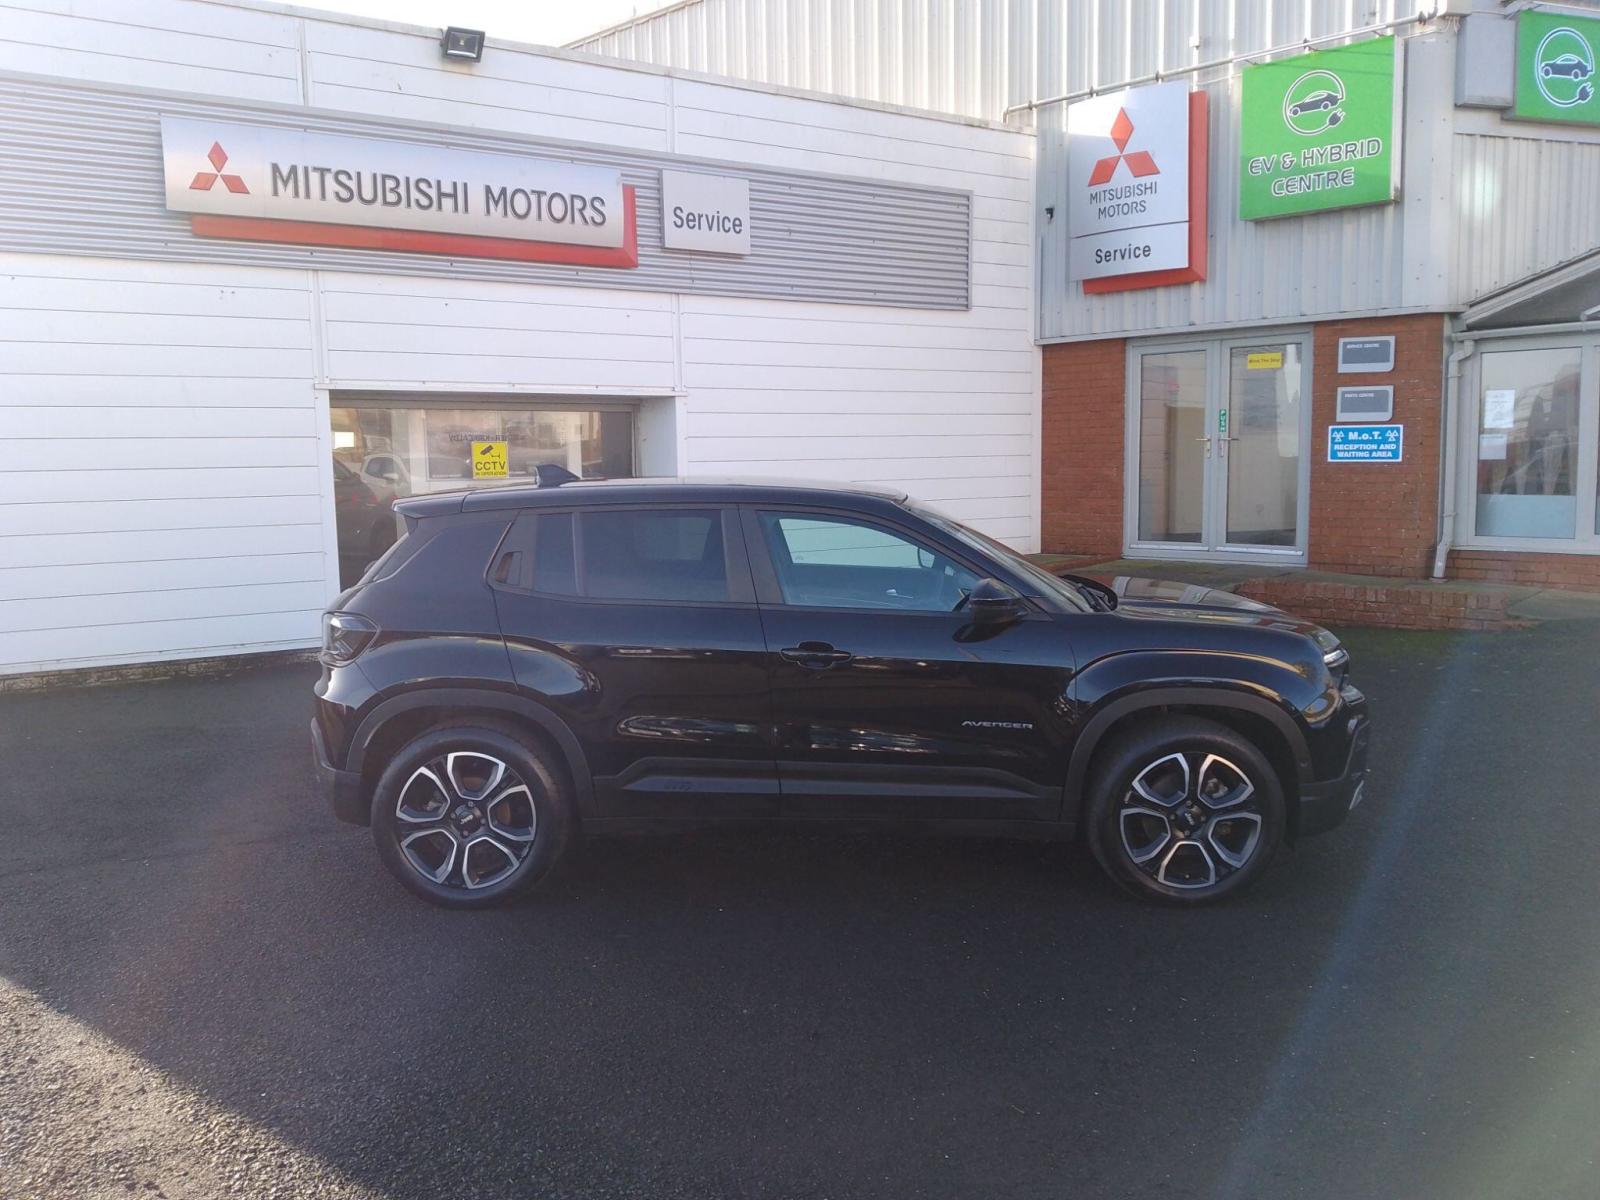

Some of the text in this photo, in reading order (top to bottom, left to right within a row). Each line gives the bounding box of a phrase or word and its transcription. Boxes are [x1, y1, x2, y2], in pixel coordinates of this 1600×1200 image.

[1249, 137, 1382, 175] EV & HYBRID
[1089, 181, 1158, 204] MITSUBISHI
[1272, 167, 1354, 197] CENTRE
[270, 162, 607, 227] MITSUBISHI MOTORS
[672, 206, 743, 234] Service
[1098, 200, 1147, 220] MOTORS
[1095, 243, 1152, 264] Service
[475, 461, 506, 471] CCTV
[961, 720, 1033, 730] AVENGER
